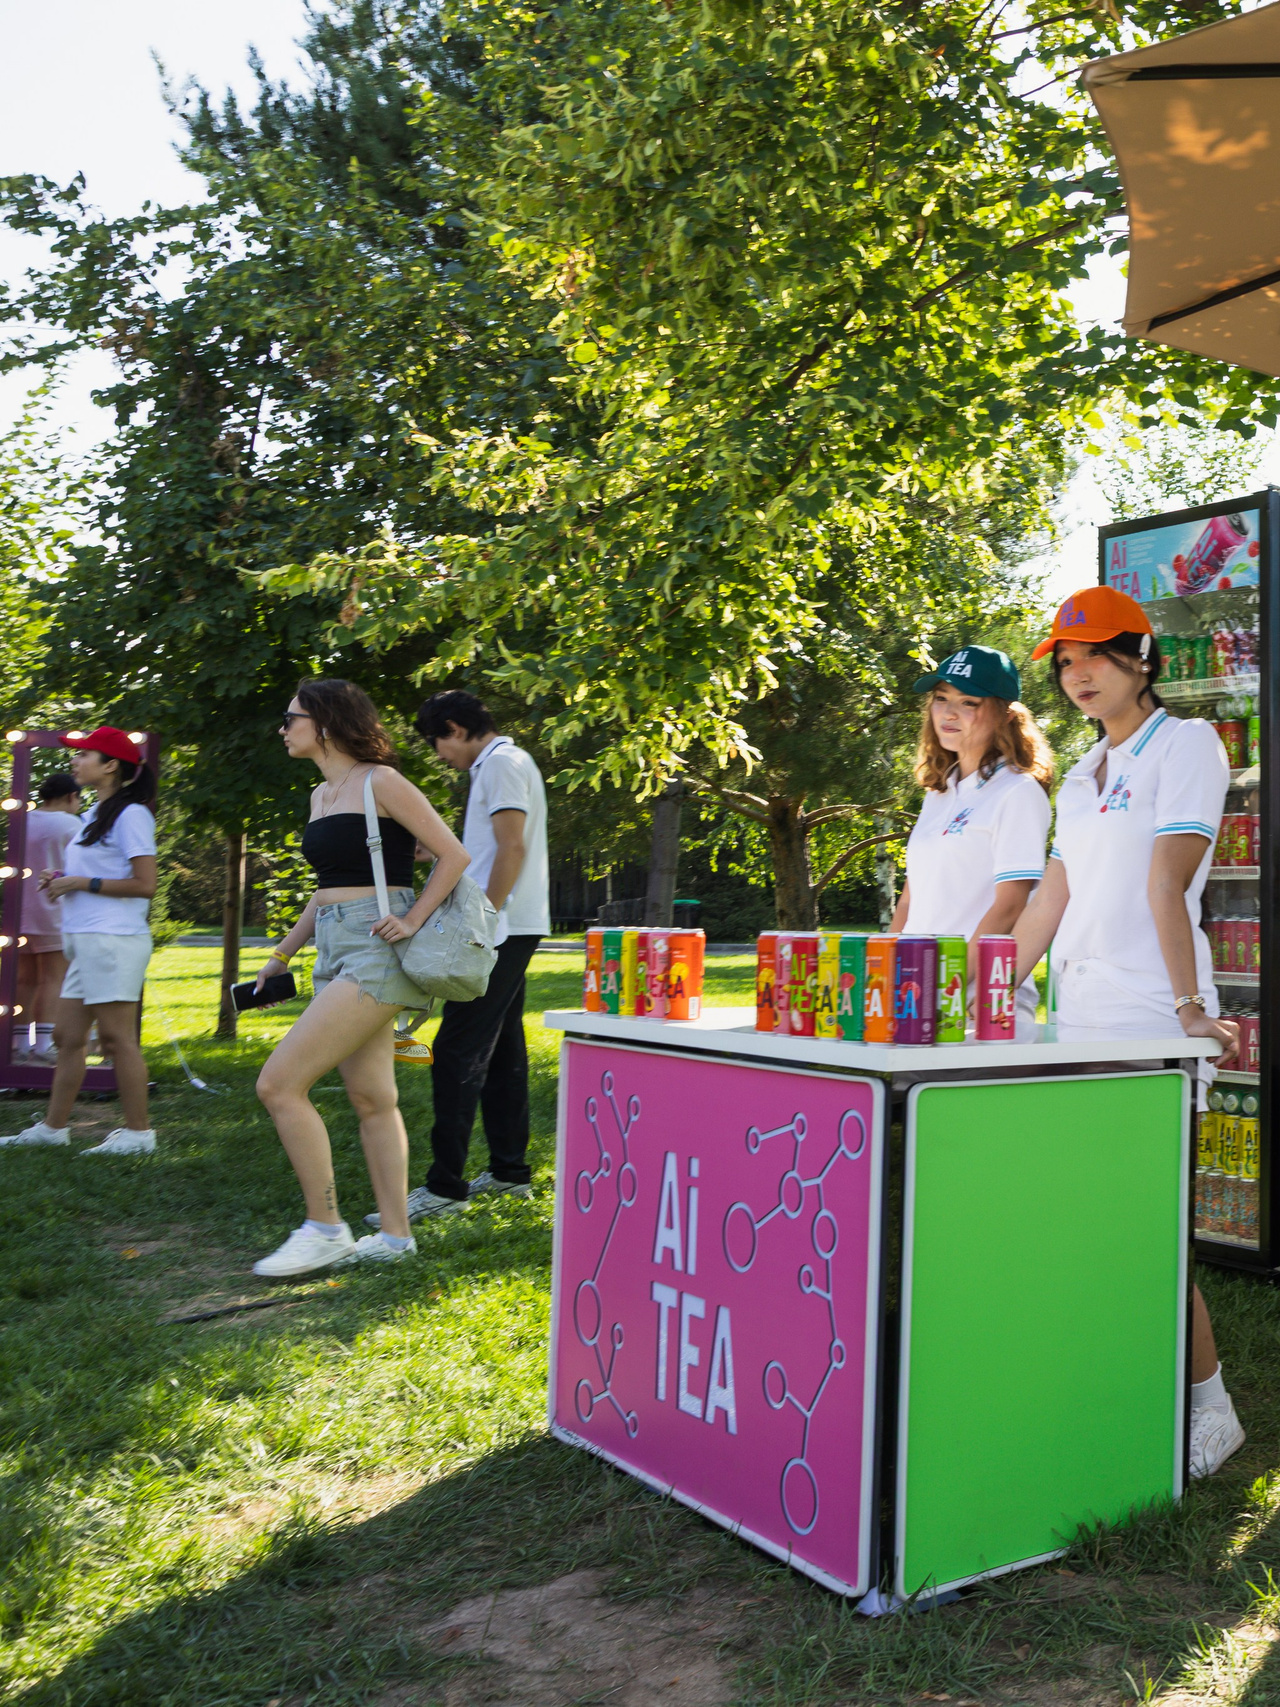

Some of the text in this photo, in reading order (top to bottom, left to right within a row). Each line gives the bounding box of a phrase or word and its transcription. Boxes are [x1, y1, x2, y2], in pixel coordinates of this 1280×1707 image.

[1110, 540, 1127, 571] Ai
[1059, 611, 1086, 629] TEA
[945, 662, 973, 678] TEA
[951, 651, 969, 663] Ai
[790, 953, 807, 981] Ai
[989, 956, 1012, 985] Ai
[652, 1150, 699, 1276] Ai
[650, 1280, 738, 1436] TEA
